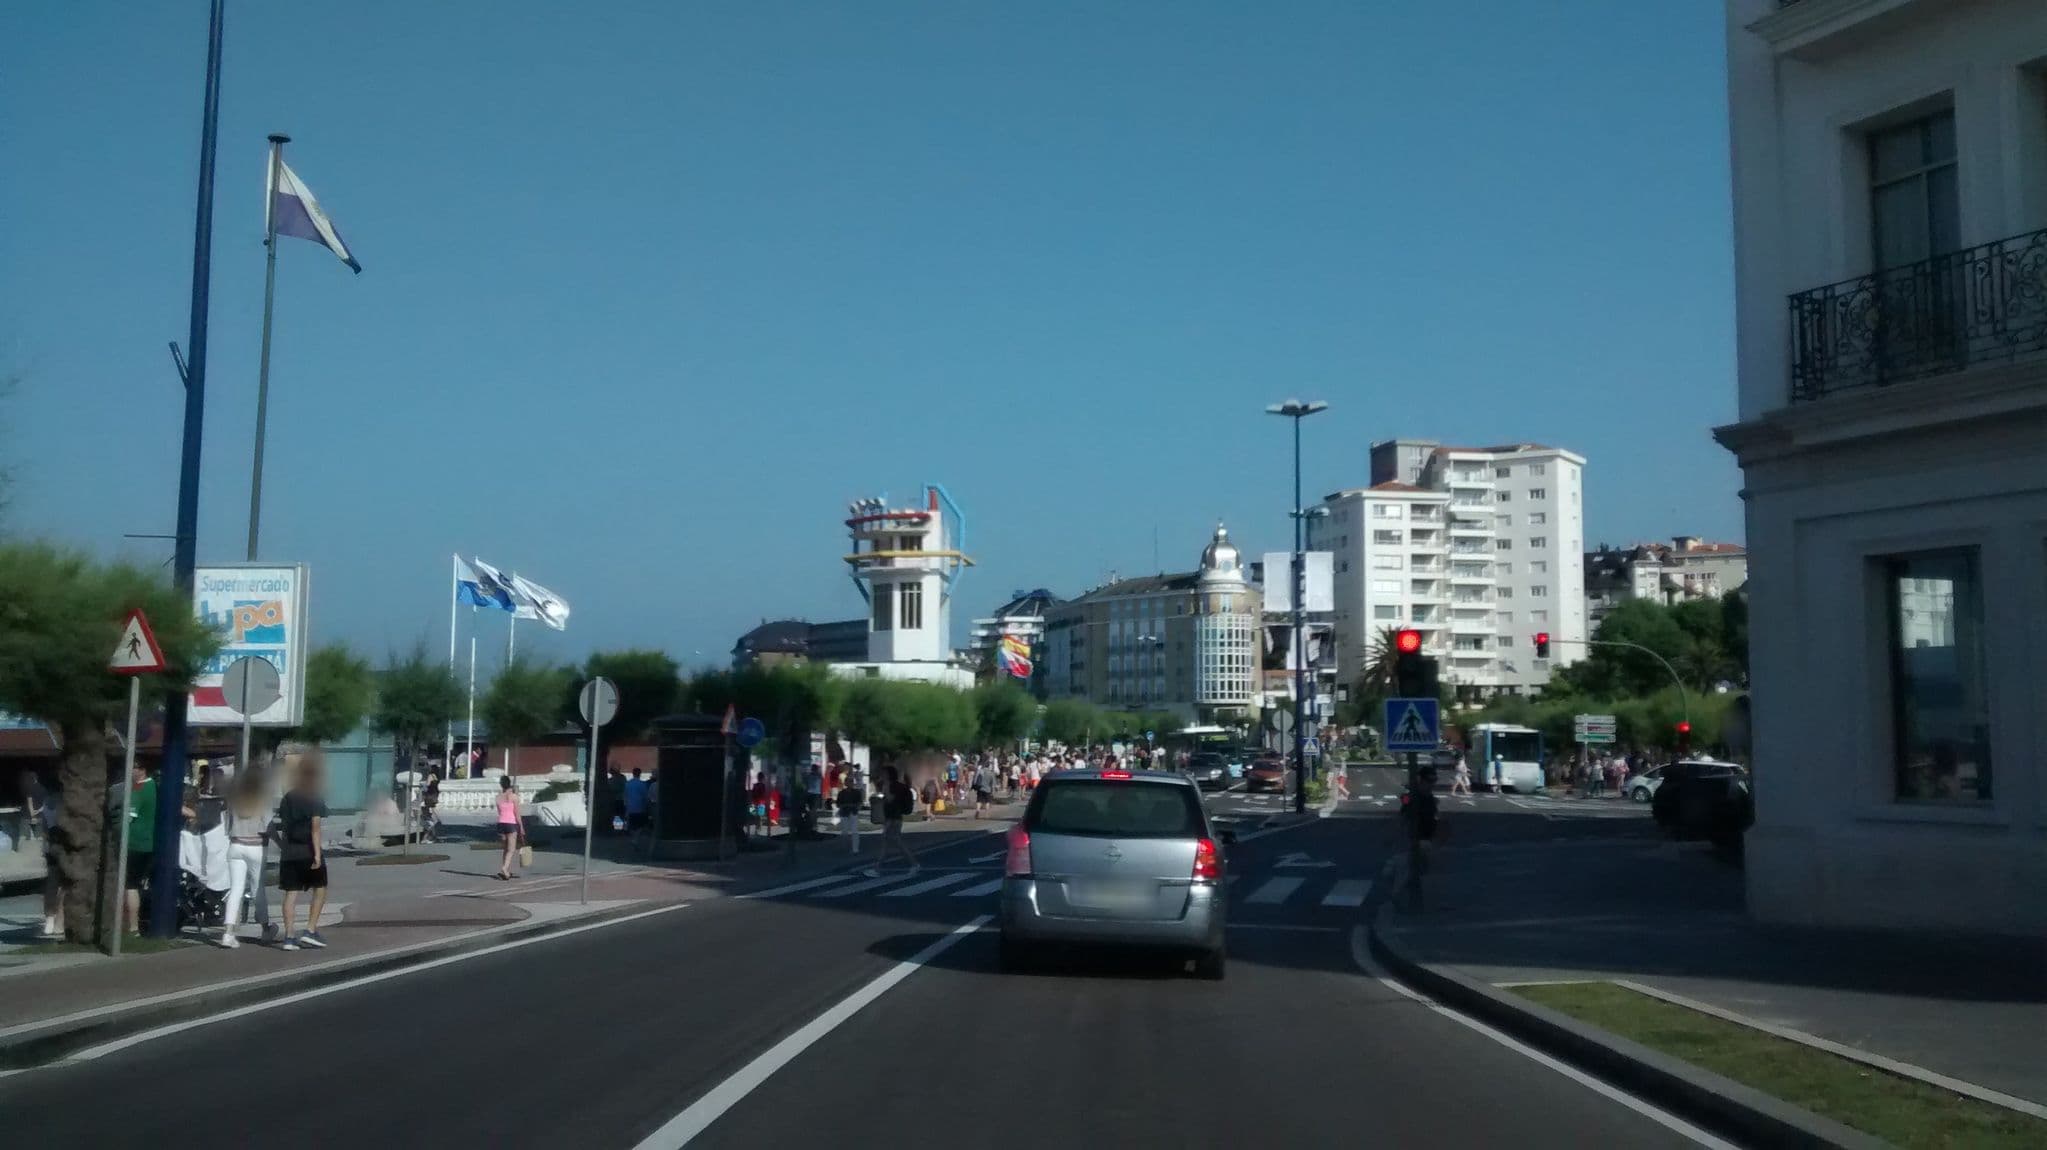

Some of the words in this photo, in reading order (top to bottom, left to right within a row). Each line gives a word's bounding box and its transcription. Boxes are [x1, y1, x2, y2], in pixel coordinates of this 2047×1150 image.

[201, 576, 290, 596] Supermercado
[201, 599, 284, 641] lupa
[219, 651, 283, 672] PAÁ
